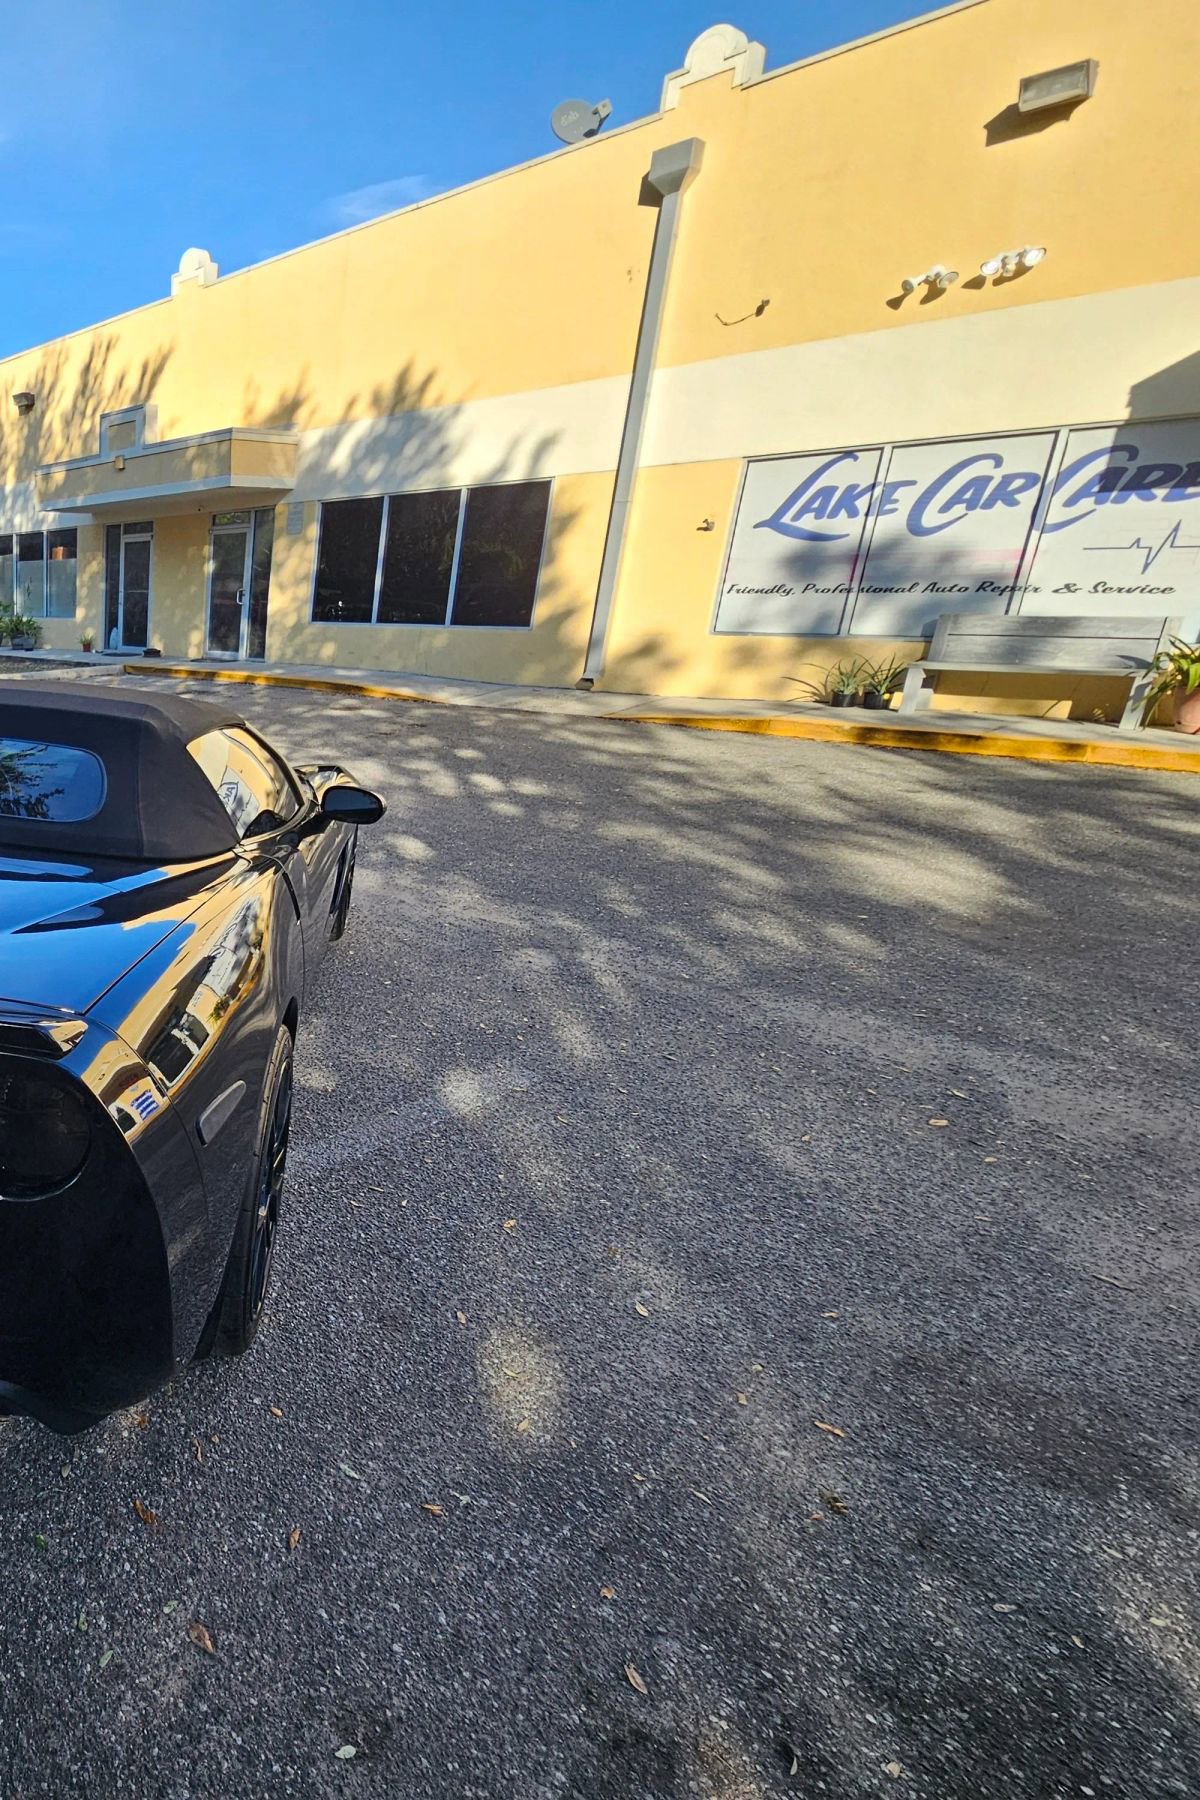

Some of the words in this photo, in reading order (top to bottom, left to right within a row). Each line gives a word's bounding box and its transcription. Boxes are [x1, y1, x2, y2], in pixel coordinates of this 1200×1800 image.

[753, 451, 918, 542] LAKE
[906, 452, 1041, 538] CAR
[726, 583, 796, 597] Friendly,
[921, 581, 970, 594] Auto
[975, 580, 1042, 597] Repair
[1051, 582, 1083, 595] &
[1087, 580, 1177, 595] Service
